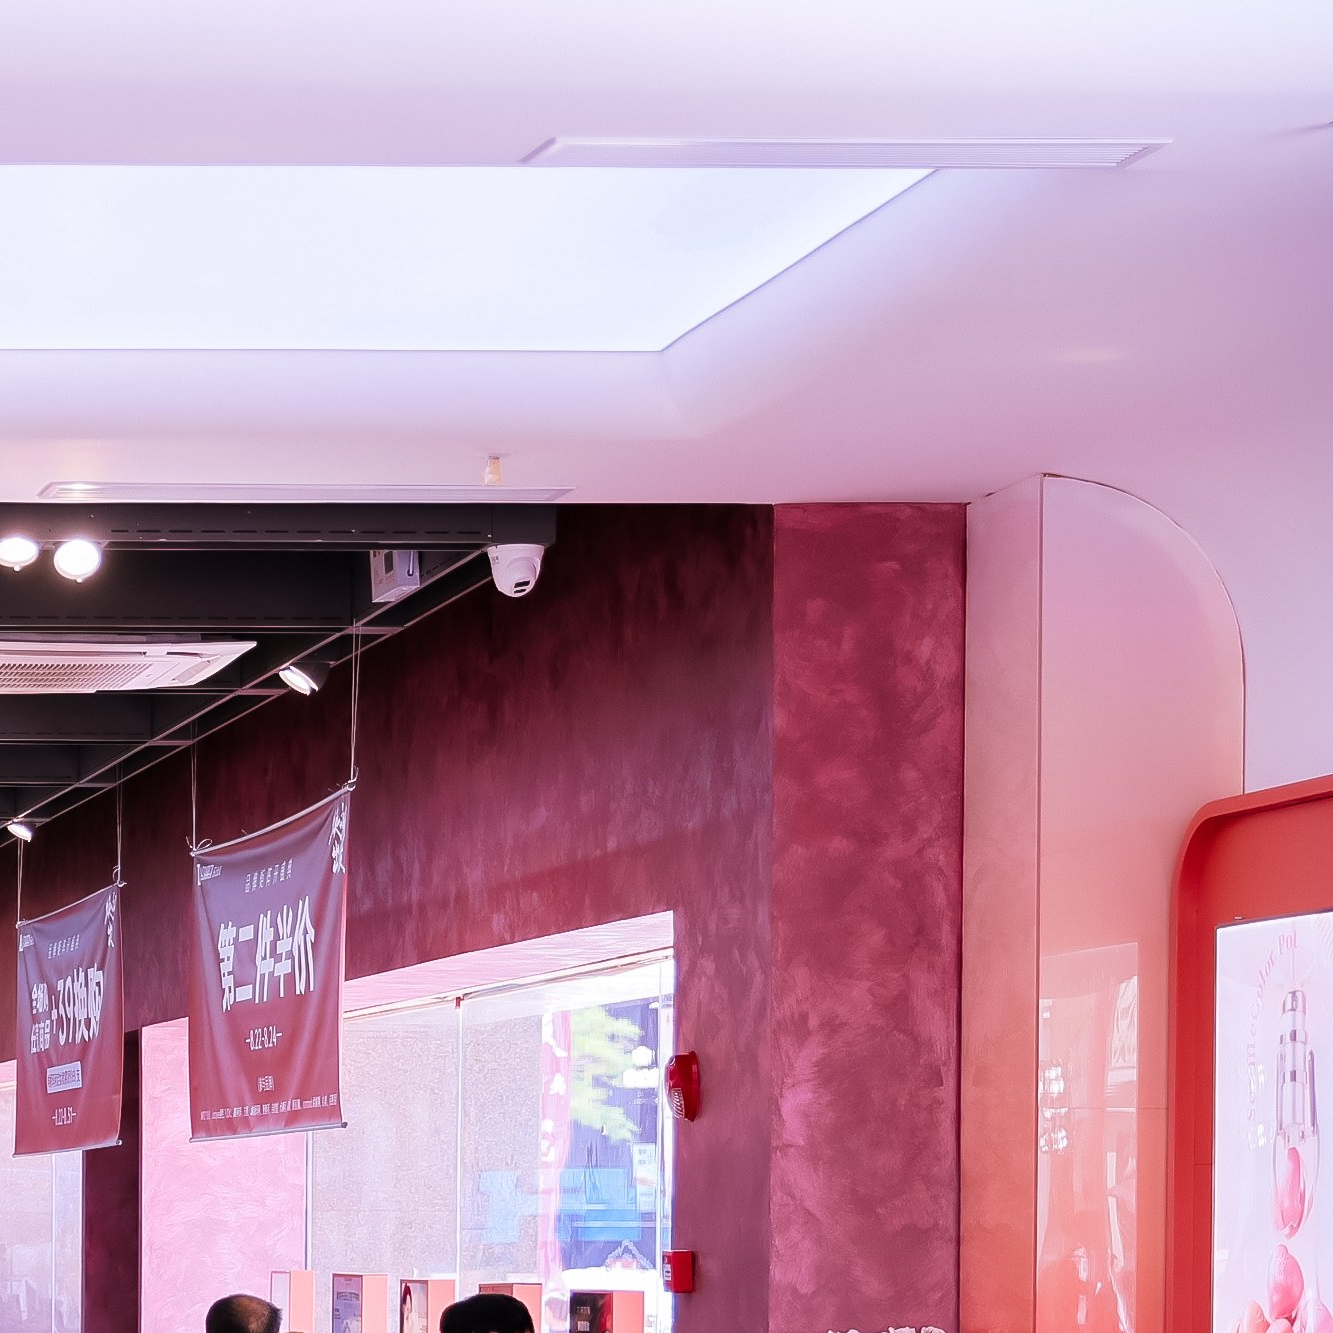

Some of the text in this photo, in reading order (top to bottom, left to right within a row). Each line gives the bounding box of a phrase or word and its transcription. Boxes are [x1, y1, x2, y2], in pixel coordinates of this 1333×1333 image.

[218, 896, 314, 1012] 第二件半价
